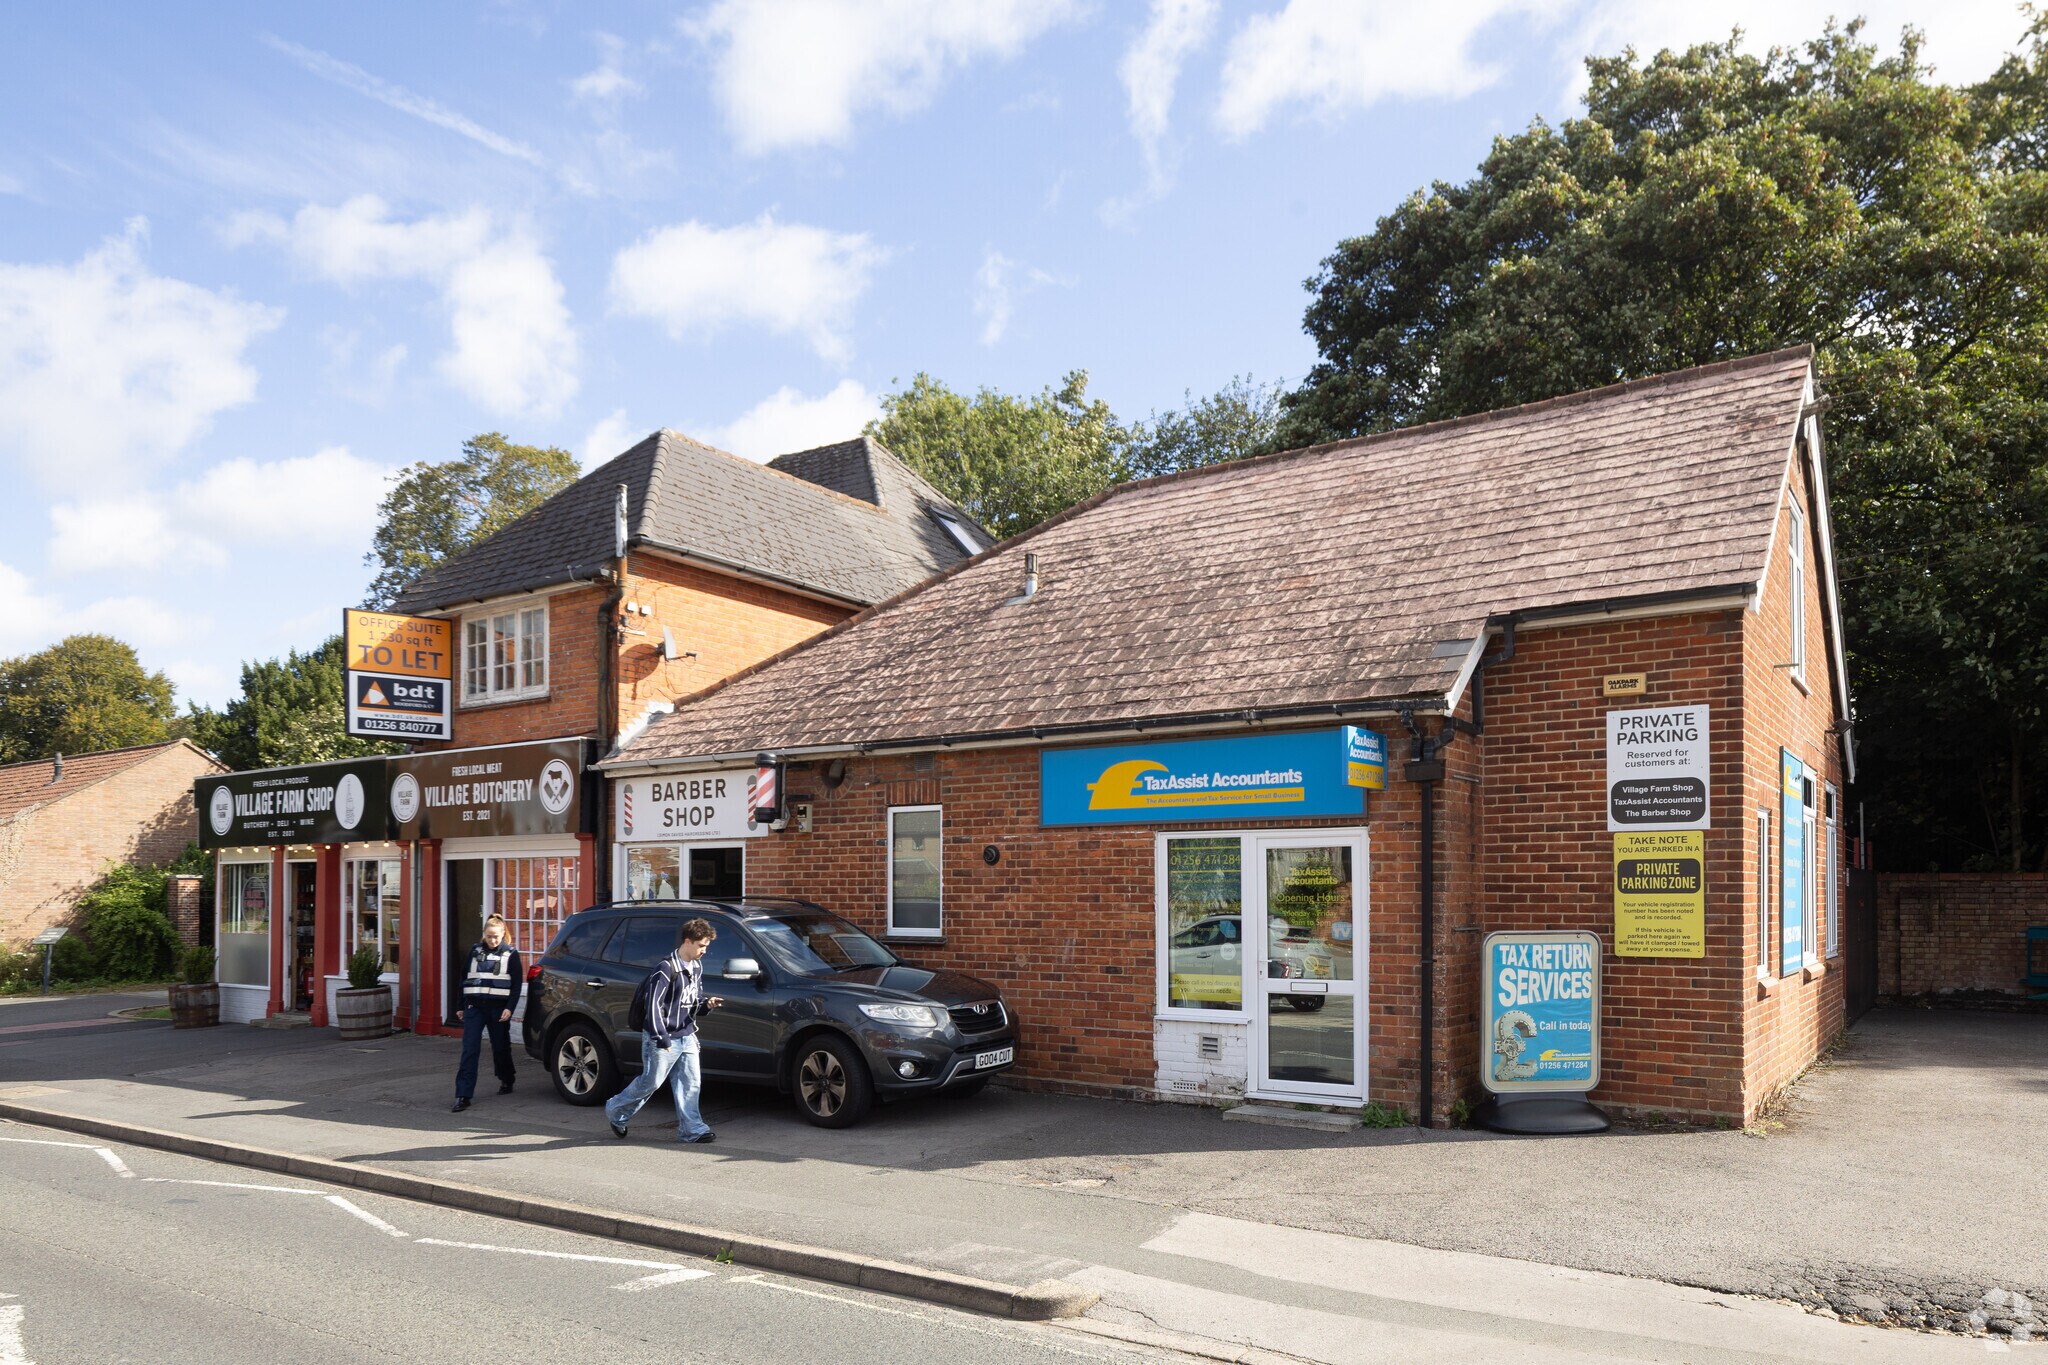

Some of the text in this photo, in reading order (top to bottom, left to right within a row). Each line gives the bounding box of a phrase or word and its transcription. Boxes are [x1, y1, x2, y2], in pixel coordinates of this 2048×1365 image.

[359, 617, 442, 634] OFFICE SUITE
[406, 637, 420, 647] sq
[424, 637, 433, 646] ft
[358, 645, 443, 670] TO LET
[1608, 678, 1639, 686] OAKPARK
[394, 683, 435, 698] bdt
[365, 720, 437, 732] 01256 840777
[1620, 712, 1695, 729] PRIVATE
[1355, 733, 1378, 748] TaxAssist
[1617, 728, 1698, 746] PARKING
[1350, 745, 1382, 762] Accountants
[1627, 749, 1689, 759] Reserved for
[452, 763, 502, 776] FRESH LOCAL MEAT
[1625, 759, 1675, 768] customers
[1144, 769, 1302, 790] TaxAssist Accountants
[425, 779, 533, 807] VILLAGE BUTCHERY
[652, 778, 726, 802] BARBER
[1622, 786, 1648, 794] Village
[1672, 784, 1693, 792] Shop
[235, 787, 334, 816] VILLAGE FARM SHOP
[463, 810, 490, 820] EST. 2021
[662, 806, 715, 827] SHOP
[1659, 836, 1688, 844] NOTE
[1171, 855, 1240, 865] 01256 471284
[1290, 867, 1332, 876] TaxAssist
[1636, 863, 1680, 875] PRIVATE
[1284, 877, 1337, 885] Accountants
[1277, 893, 1314, 904] Opening
[1500, 945, 1592, 970] TAX RETURN
[1498, 968, 1592, 1007] SERVICES
[1540, 1021, 1556, 1030] Call
[1570, 1021, 1591, 1031] today
